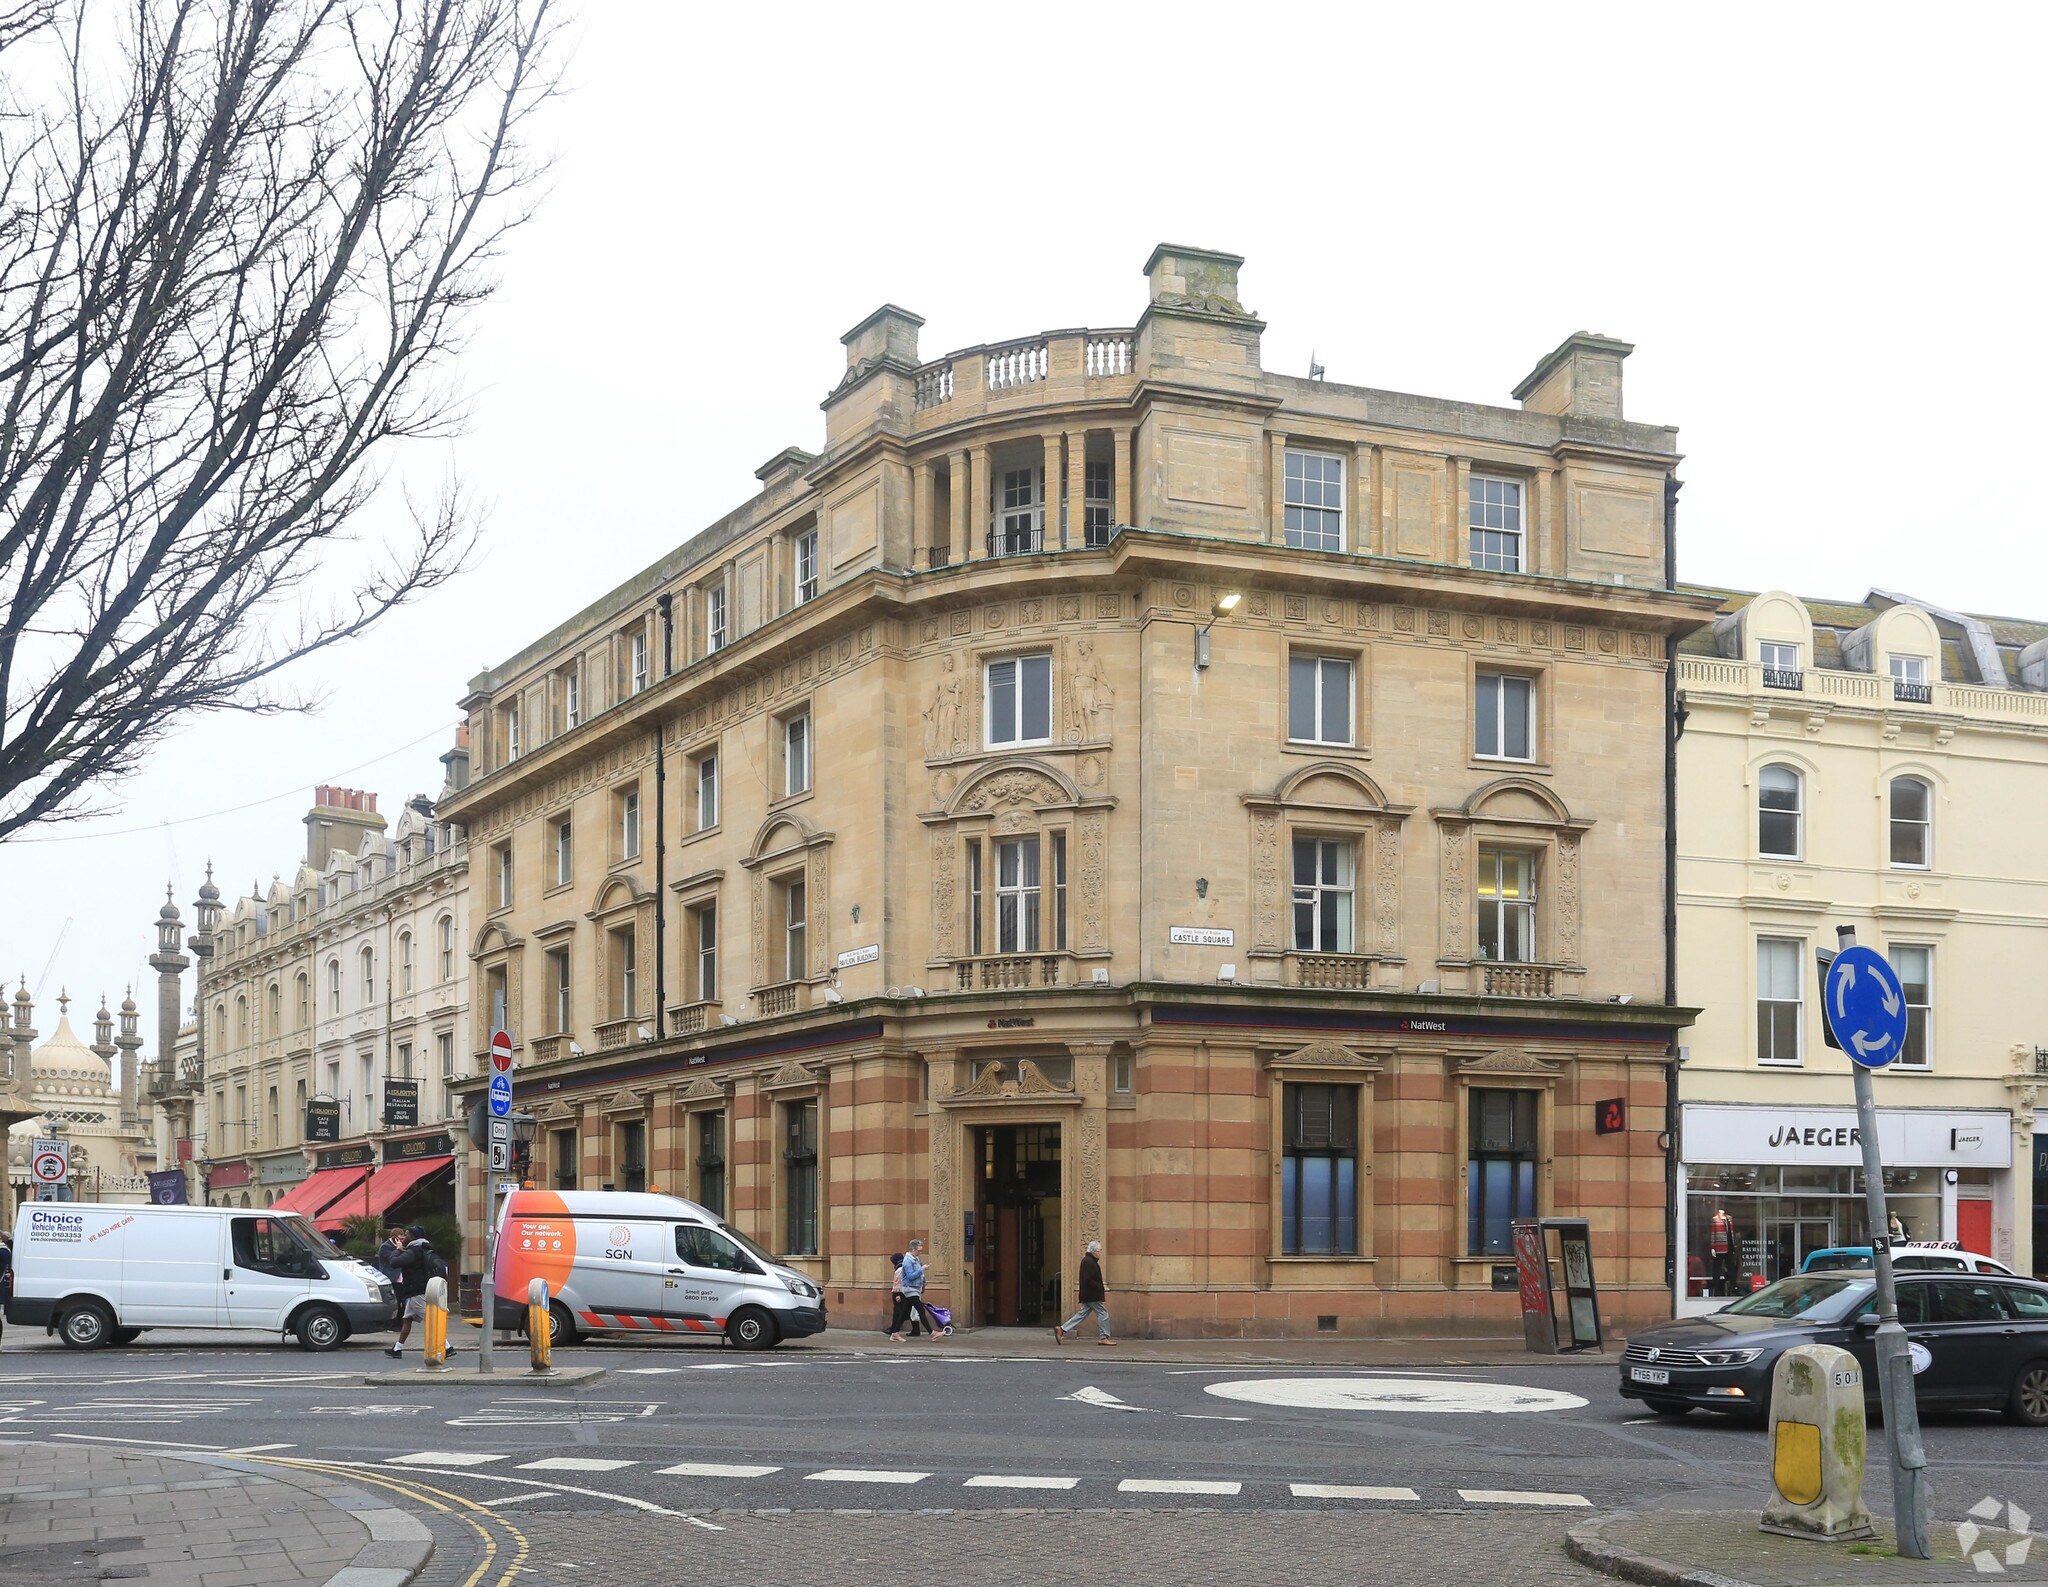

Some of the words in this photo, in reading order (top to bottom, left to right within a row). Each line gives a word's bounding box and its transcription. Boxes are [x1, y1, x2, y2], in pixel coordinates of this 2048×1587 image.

[1173, 934, 1199, 943] CASTLE
[1202, 935, 1231, 944] SQUARE
[839, 957, 856, 966] PAVILION
[856, 951, 877, 963] BUILDINGS
[997, 1017, 1035, 1028] NatWest
[1410, 1020, 1446, 1031] NatWest
[495, 1126, 506, 1136] Only
[1769, 1125, 1861, 1147] JAEGER
[1957, 1135, 1981, 1143] JAEGER
[32, 1212, 83, 1224] Choice
[32, 1222, 55, 1231] Vehicle
[57, 1223, 83, 1232] Rentals
[88, 1234, 98, 1243] WE
[97, 1228, 110, 1238] ALSO
[110, 1222, 121, 1232] HIRE
[121, 1215, 135, 1226] CARS
[1941, 1242, 1957, 1250] 60
[605, 1248, 632, 1260] SGN
[1633, 1369, 1650, 1380] FY66
[1652, 1371, 1666, 1381] YKP
